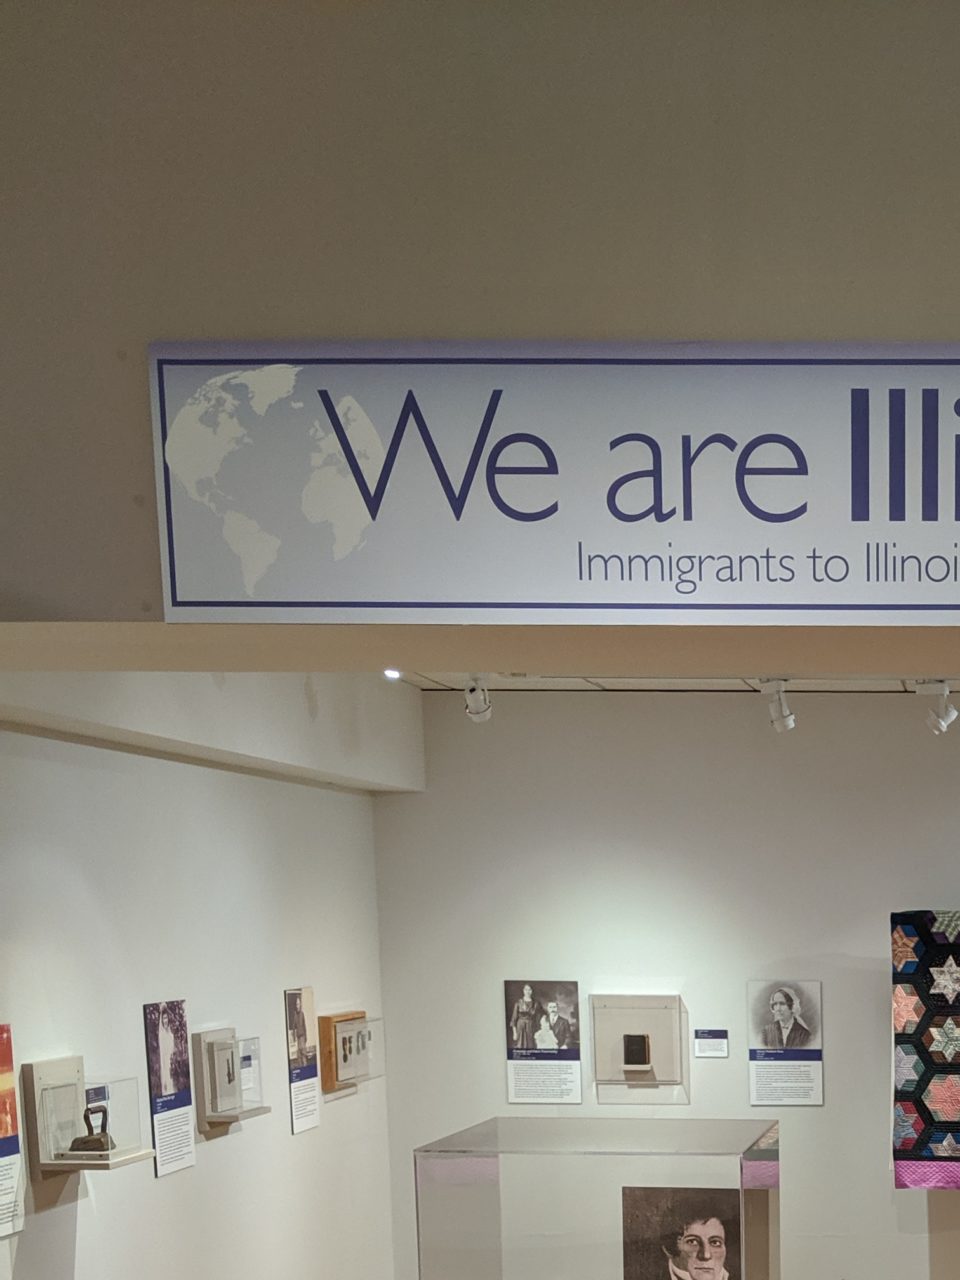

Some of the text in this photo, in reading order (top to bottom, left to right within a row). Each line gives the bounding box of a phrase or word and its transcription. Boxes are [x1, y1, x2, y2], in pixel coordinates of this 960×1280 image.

[317, 388, 562, 523] We
[605, 432, 809, 523] are
[577, 541, 796, 595] Immigrants
[805, 546, 850, 583] to
